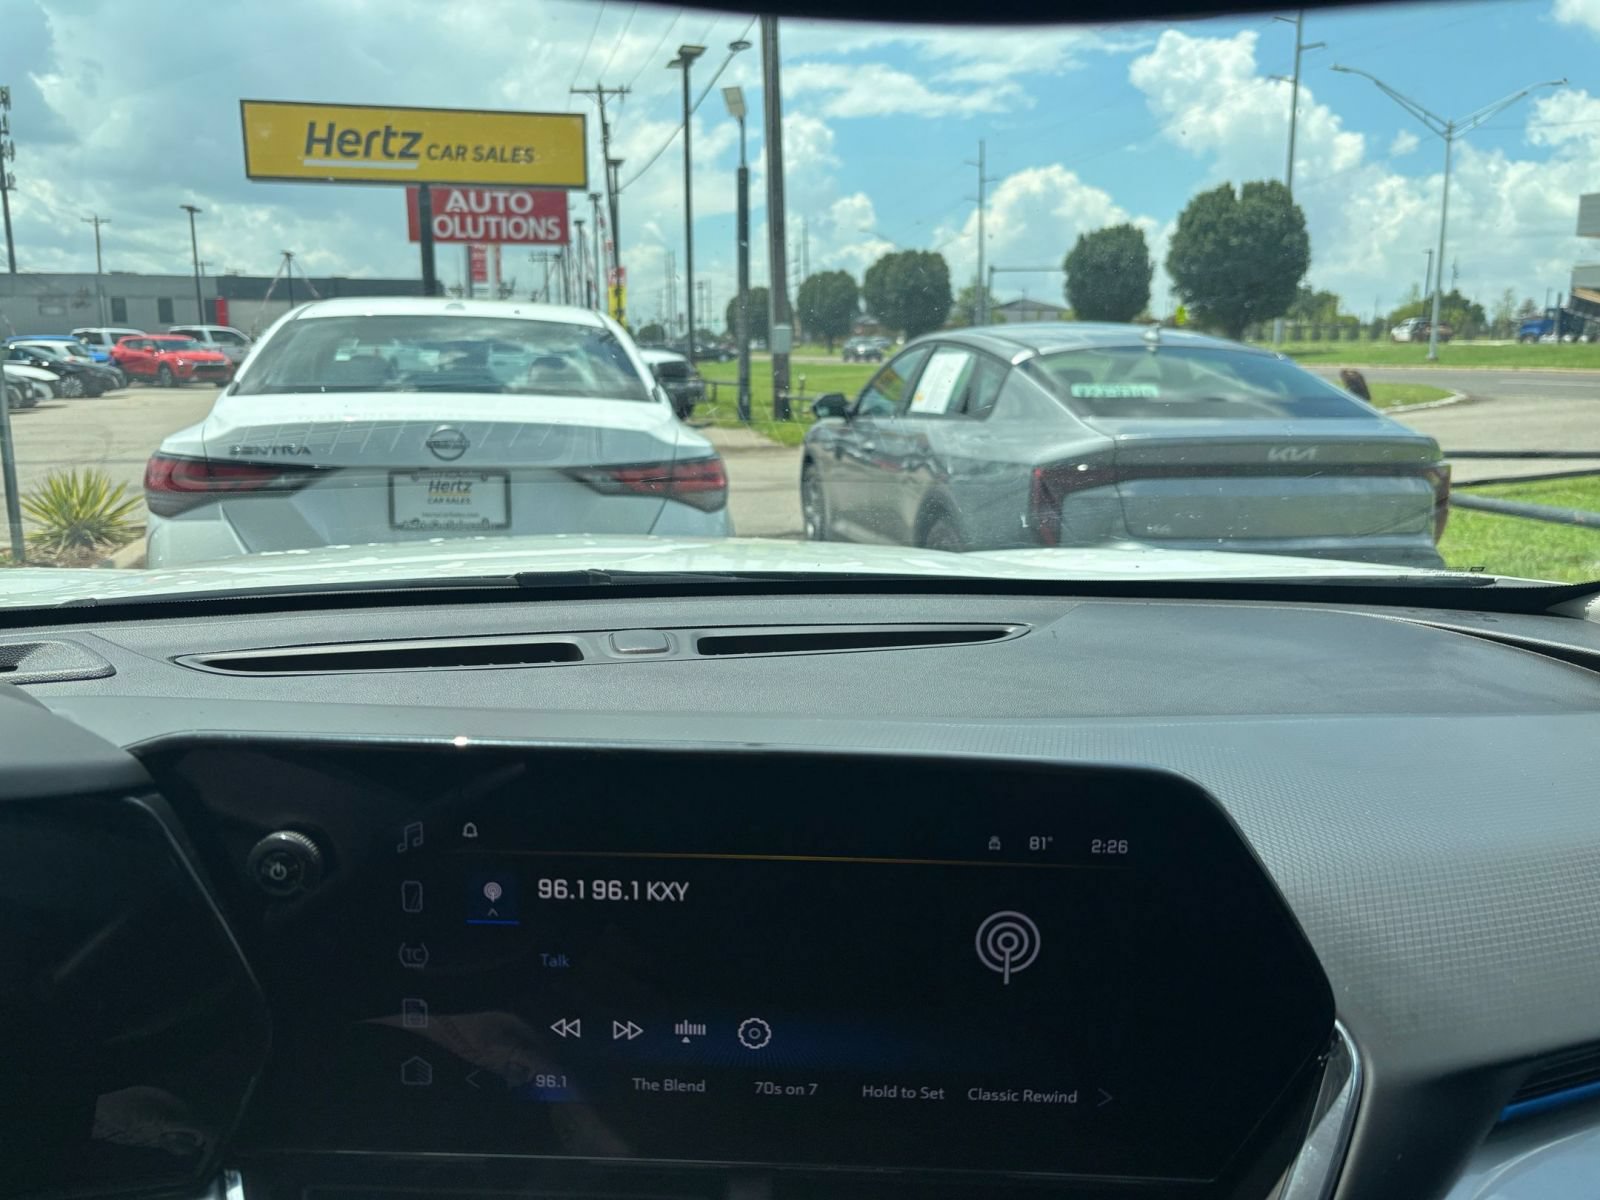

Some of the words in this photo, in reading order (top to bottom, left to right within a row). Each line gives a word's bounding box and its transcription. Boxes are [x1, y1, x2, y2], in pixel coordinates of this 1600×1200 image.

[304, 121, 423, 159] Hertz
[426, 144, 467, 162] CAR
[471, 144, 534, 164] SALES
[445, 189, 533, 214] AUTO
[433, 216, 561, 240] OLUTIONS
[428, 479, 473, 494] Hertz
[1090, 838, 1129, 854] 2:26
[537, 878, 585, 900] 96.1
[591, 879, 639, 901] 96.1
[646, 880, 690, 902] KXY
[540, 952, 570, 969] Talk
[535, 1075, 567, 1088] 96.1
[631, 1077, 661, 1092] The
[664, 1077, 706, 1093] Blend
[754, 1081, 782, 1095] 70s
[784, 1085, 805, 1095] on
[807, 1083, 819, 1096] 7
[861, 1084, 898, 1098] Hold
[900, 1086, 917, 1099] to
[919, 1086, 945, 1100] Set
[967, 1087, 1020, 1102] Classic
[1022, 1088, 1078, 1104] Rewind
